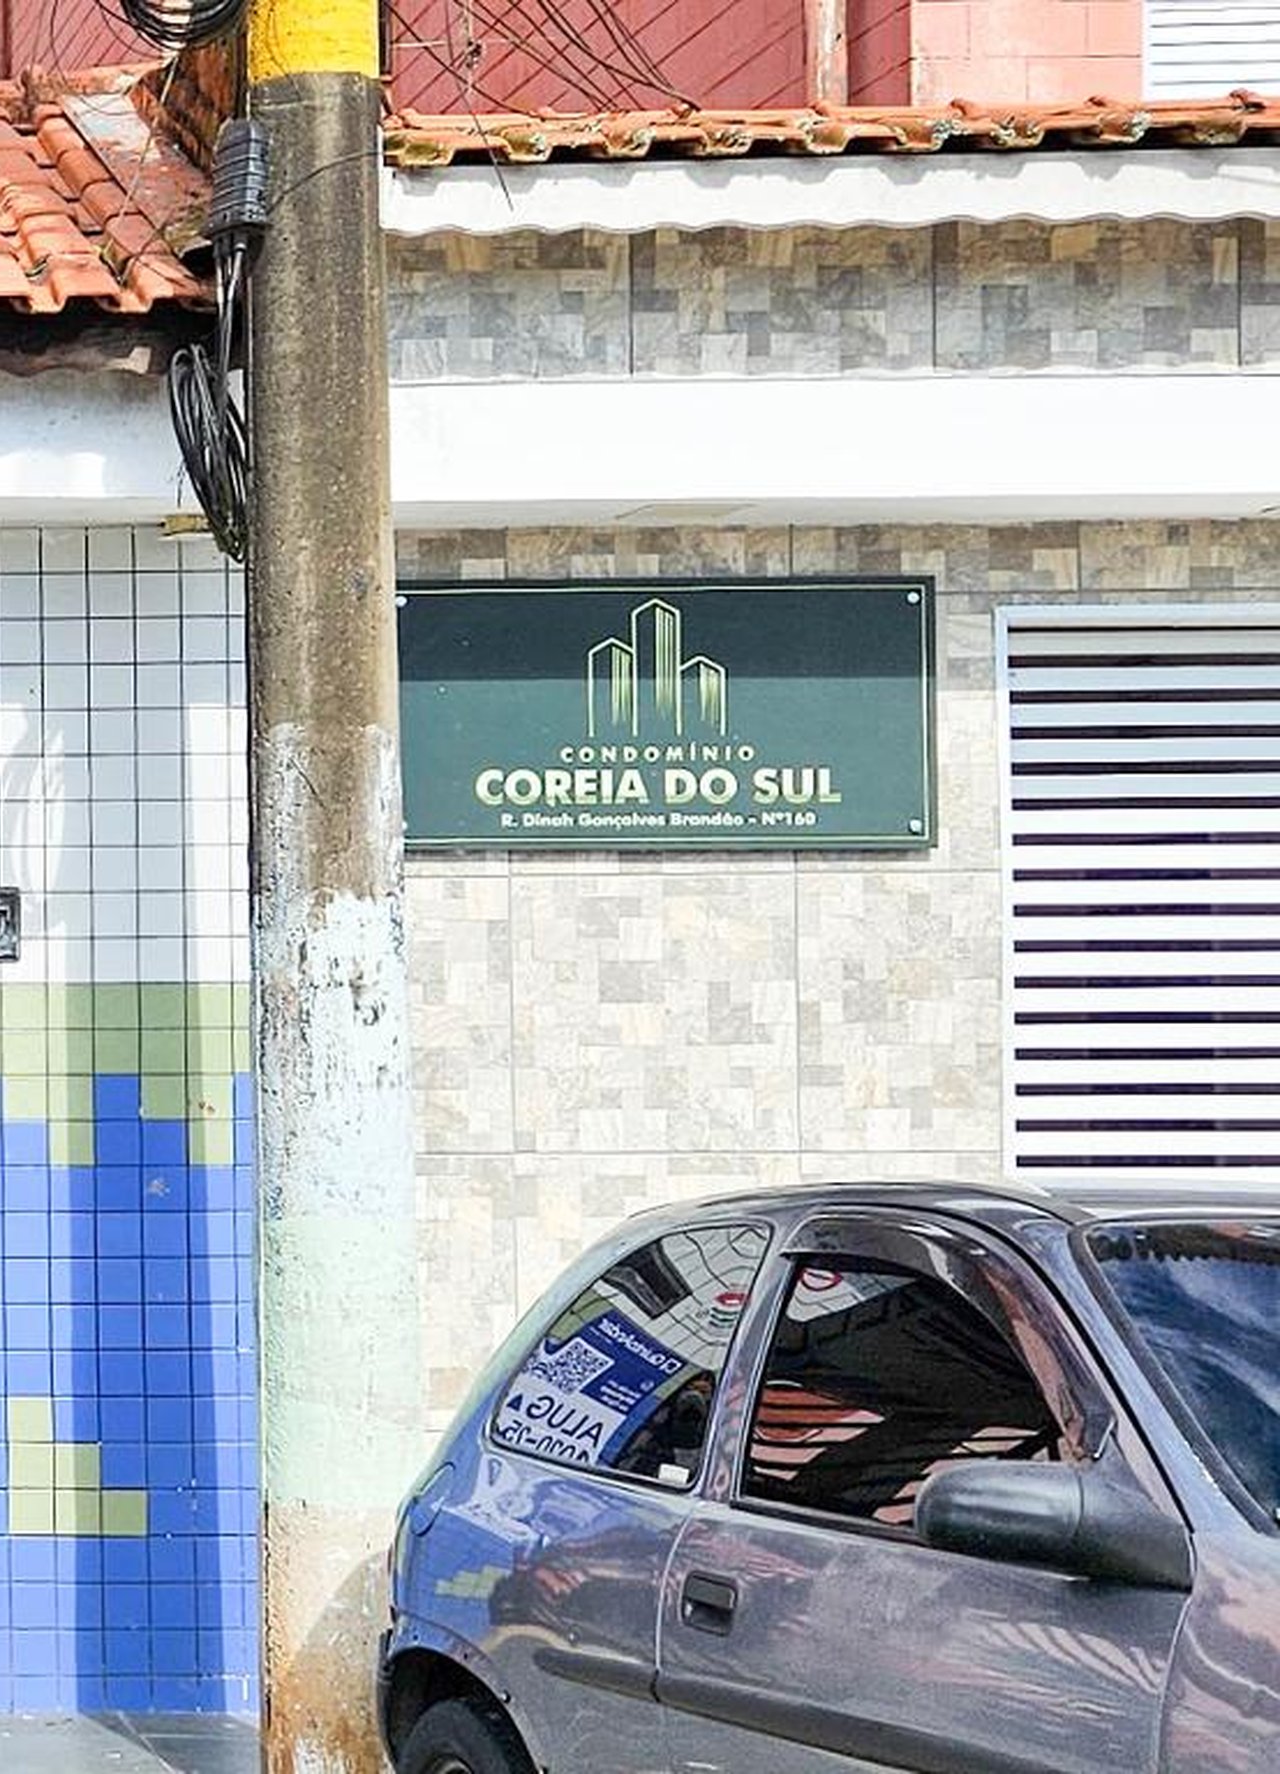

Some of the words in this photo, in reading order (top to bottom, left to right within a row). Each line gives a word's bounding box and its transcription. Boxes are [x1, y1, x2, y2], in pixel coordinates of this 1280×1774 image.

[560, 741, 755, 763] CONDOMÍNIO
[474, 768, 650, 806] COREIA
[664, 767, 738, 805] DO
[753, 767, 842, 804] SUL
[501, 813, 519, 827] R.
[523, 812, 574, 827] Dinah
[578, 812, 665, 831] Gonçalves
[670, 811, 744, 826] Brandão
